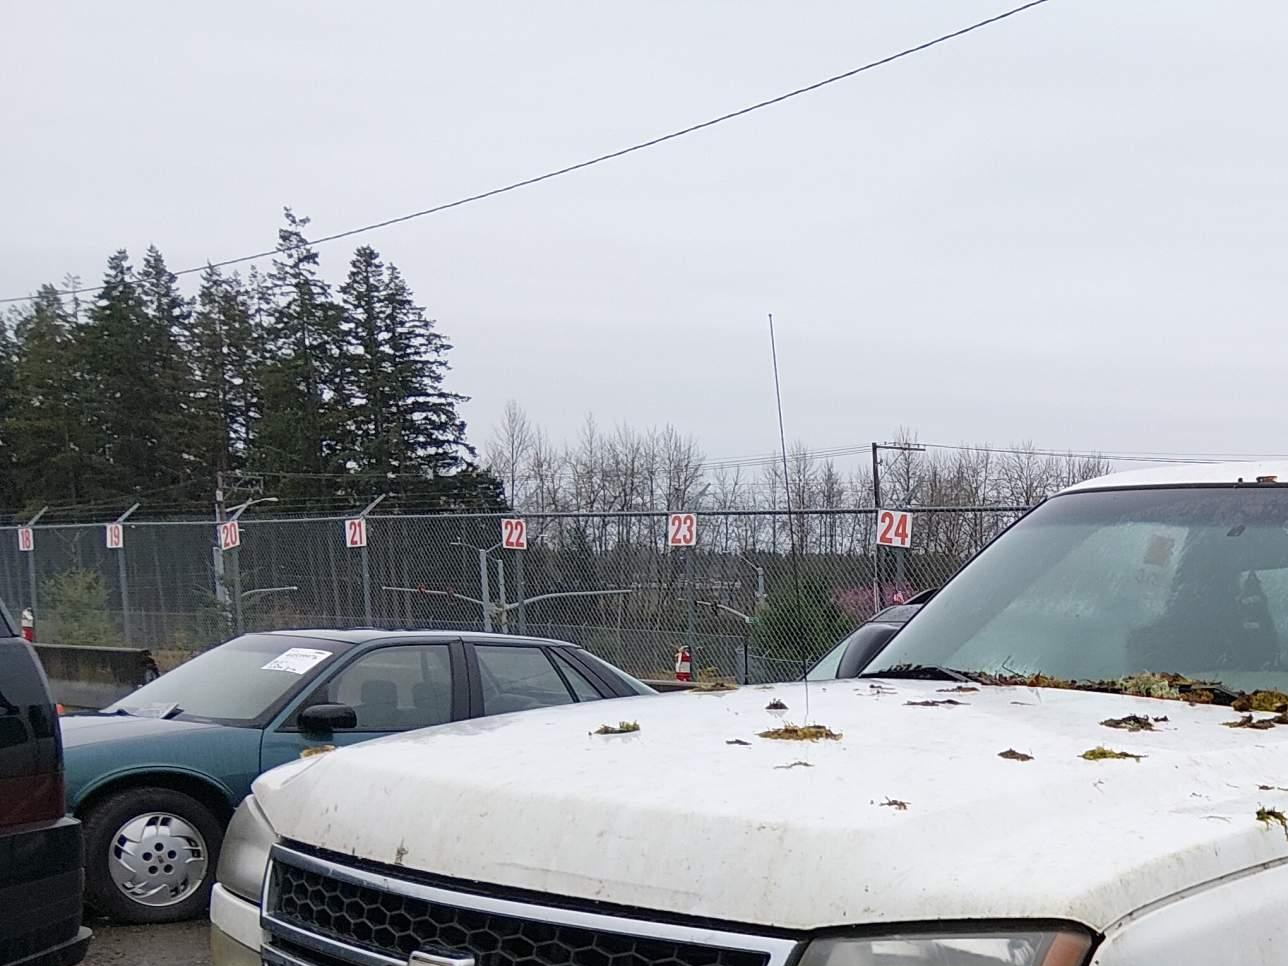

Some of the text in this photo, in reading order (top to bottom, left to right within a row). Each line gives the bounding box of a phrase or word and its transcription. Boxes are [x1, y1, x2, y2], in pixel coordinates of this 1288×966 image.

[20, 528, 31, 549] 18
[108, 527, 120, 547] 19
[222, 524, 238, 548] 20
[349, 520, 364, 546] 21
[504, 520, 525, 548] 22
[671, 515, 695, 544] 23
[879, 511, 908, 545] 24
